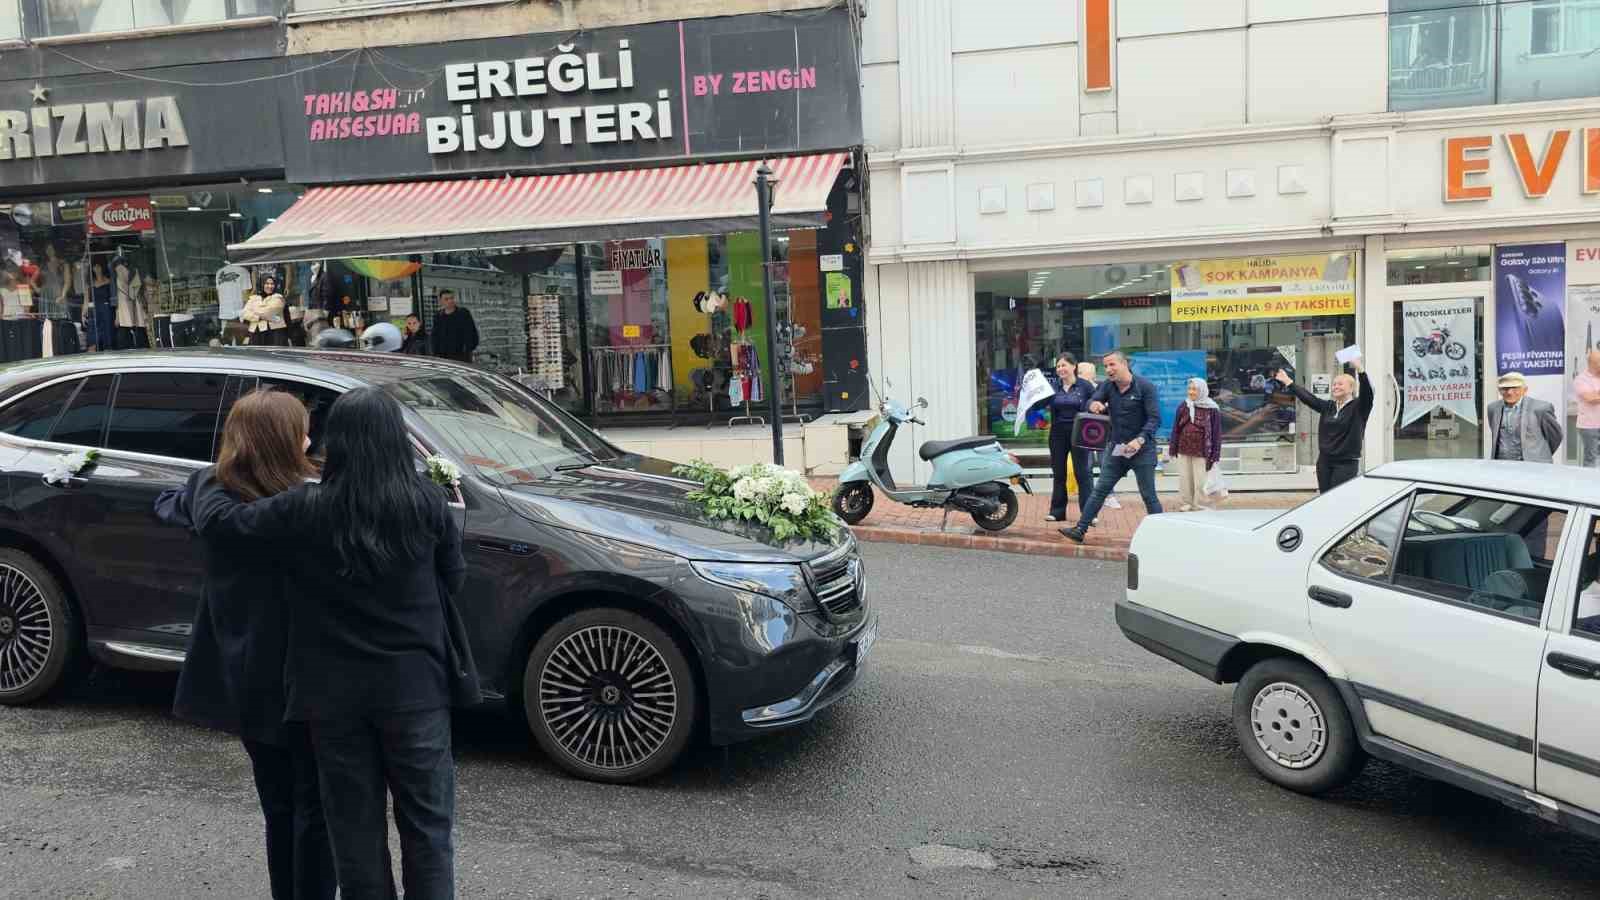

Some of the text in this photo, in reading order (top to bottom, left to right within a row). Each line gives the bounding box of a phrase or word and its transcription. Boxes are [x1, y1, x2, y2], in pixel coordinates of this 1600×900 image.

[445, 39, 634, 101] EREĞLİ
[693, 75, 723, 96] BY
[310, 111, 420, 140] AKSESUAR
[426, 89, 672, 153] BİJUTERİ
[1501, 258, 1530, 266] Galaxy
[1576, 248, 1600, 261] EV
[1239, 266, 1319, 281] KAMPANYA
[1177, 296, 1351, 316] PEŞİN FİYATINA 9 AY TAKSİTLE
[1509, 360, 1521, 368] AY
[1524, 358, 1563, 368] TAKSİTLE
[1440, 383, 1472, 391] VARAN
